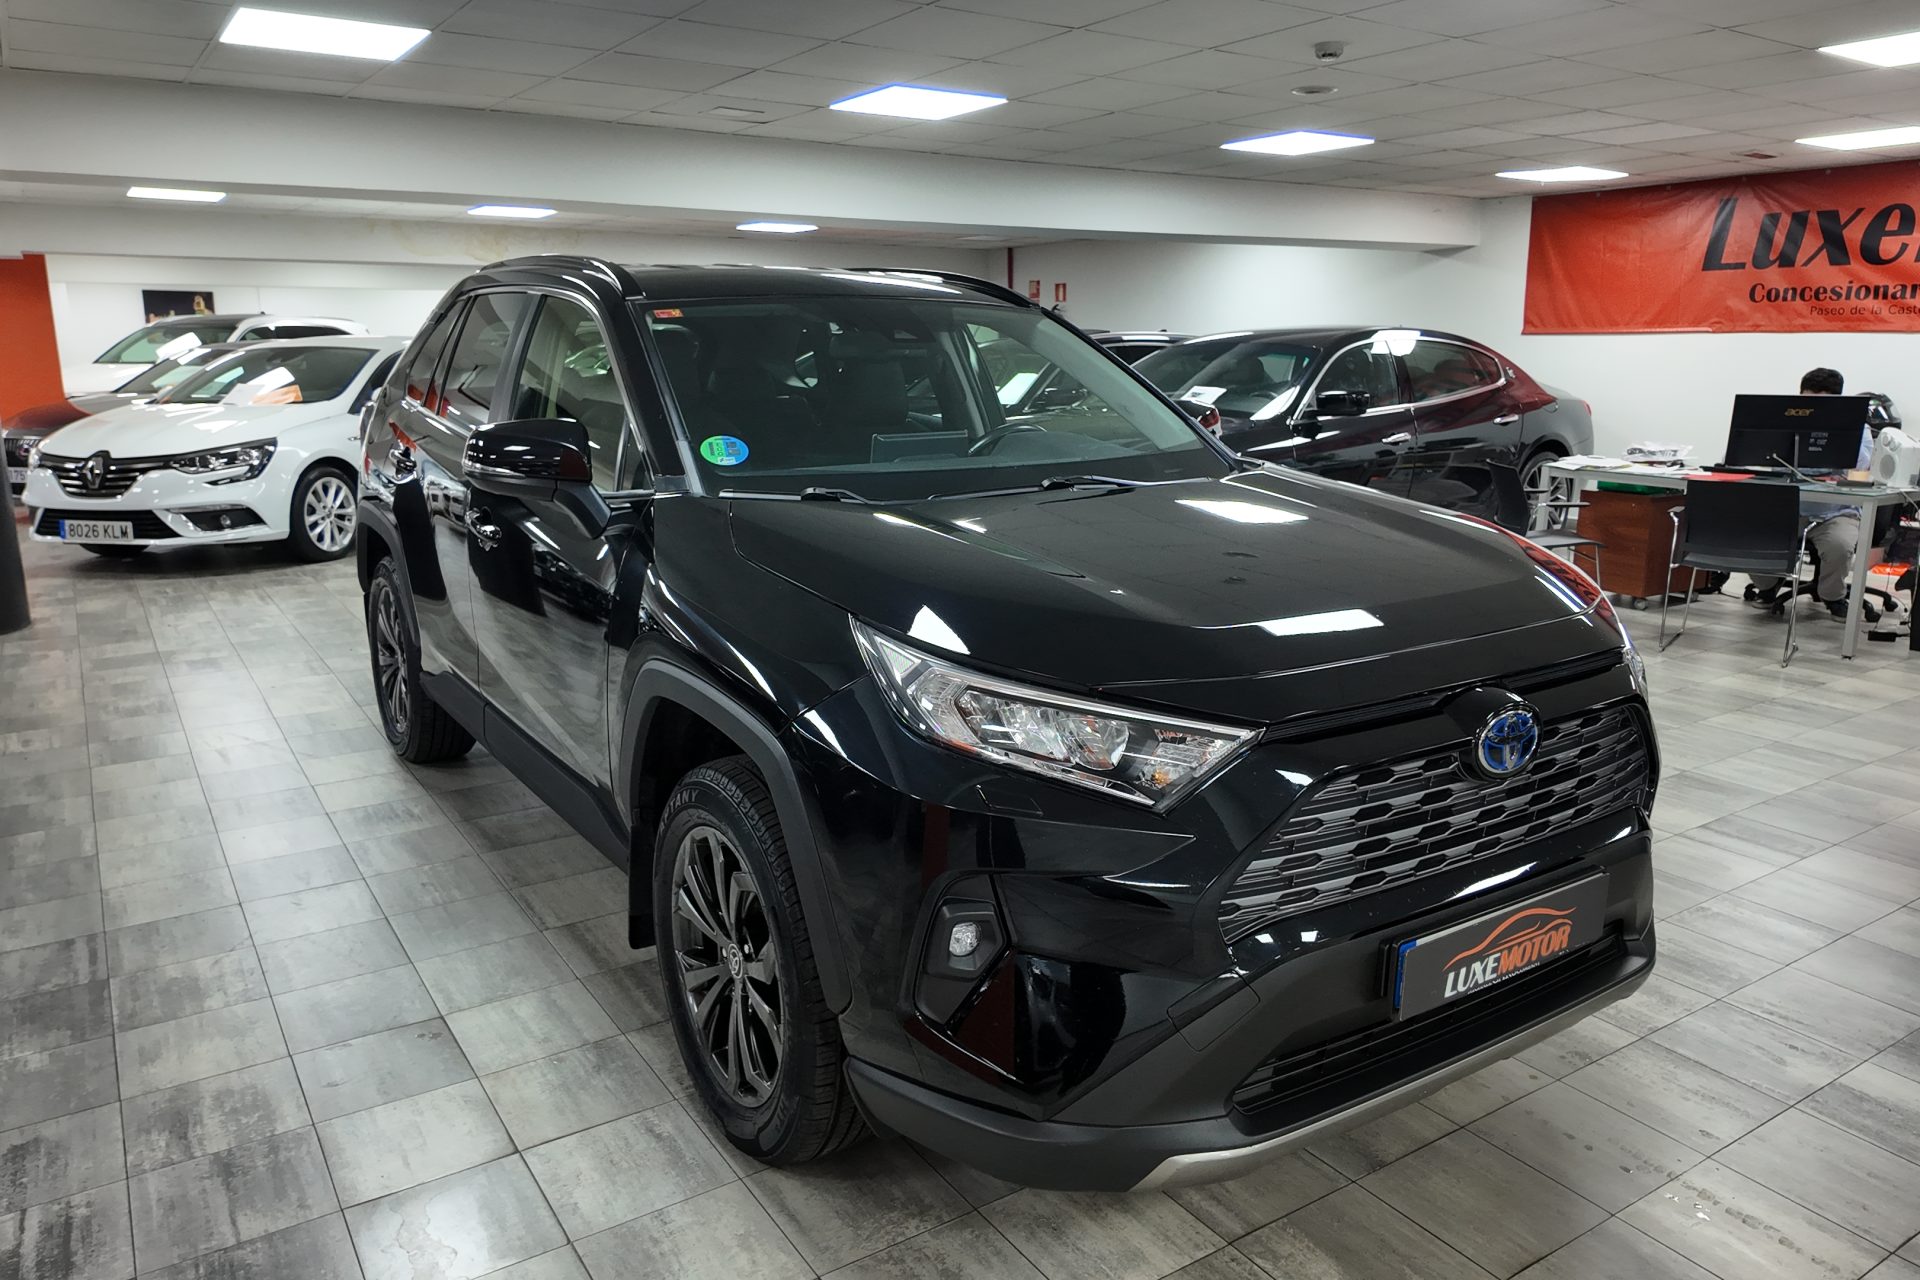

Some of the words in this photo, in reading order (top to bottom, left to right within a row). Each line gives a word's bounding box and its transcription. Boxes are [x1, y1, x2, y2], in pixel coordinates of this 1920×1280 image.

[1702, 197, 1920, 271] Luxe
[1810, 306, 1845, 316] Paseo
[1850, 305, 1866, 315] de
[1871, 305, 1882, 315] la
[1784, 408, 1815, 417] acer
[69, 523, 100, 538] 8026
[103, 524, 129, 540] KLM
[1444, 924, 1572, 998] LUXEMOTOR
